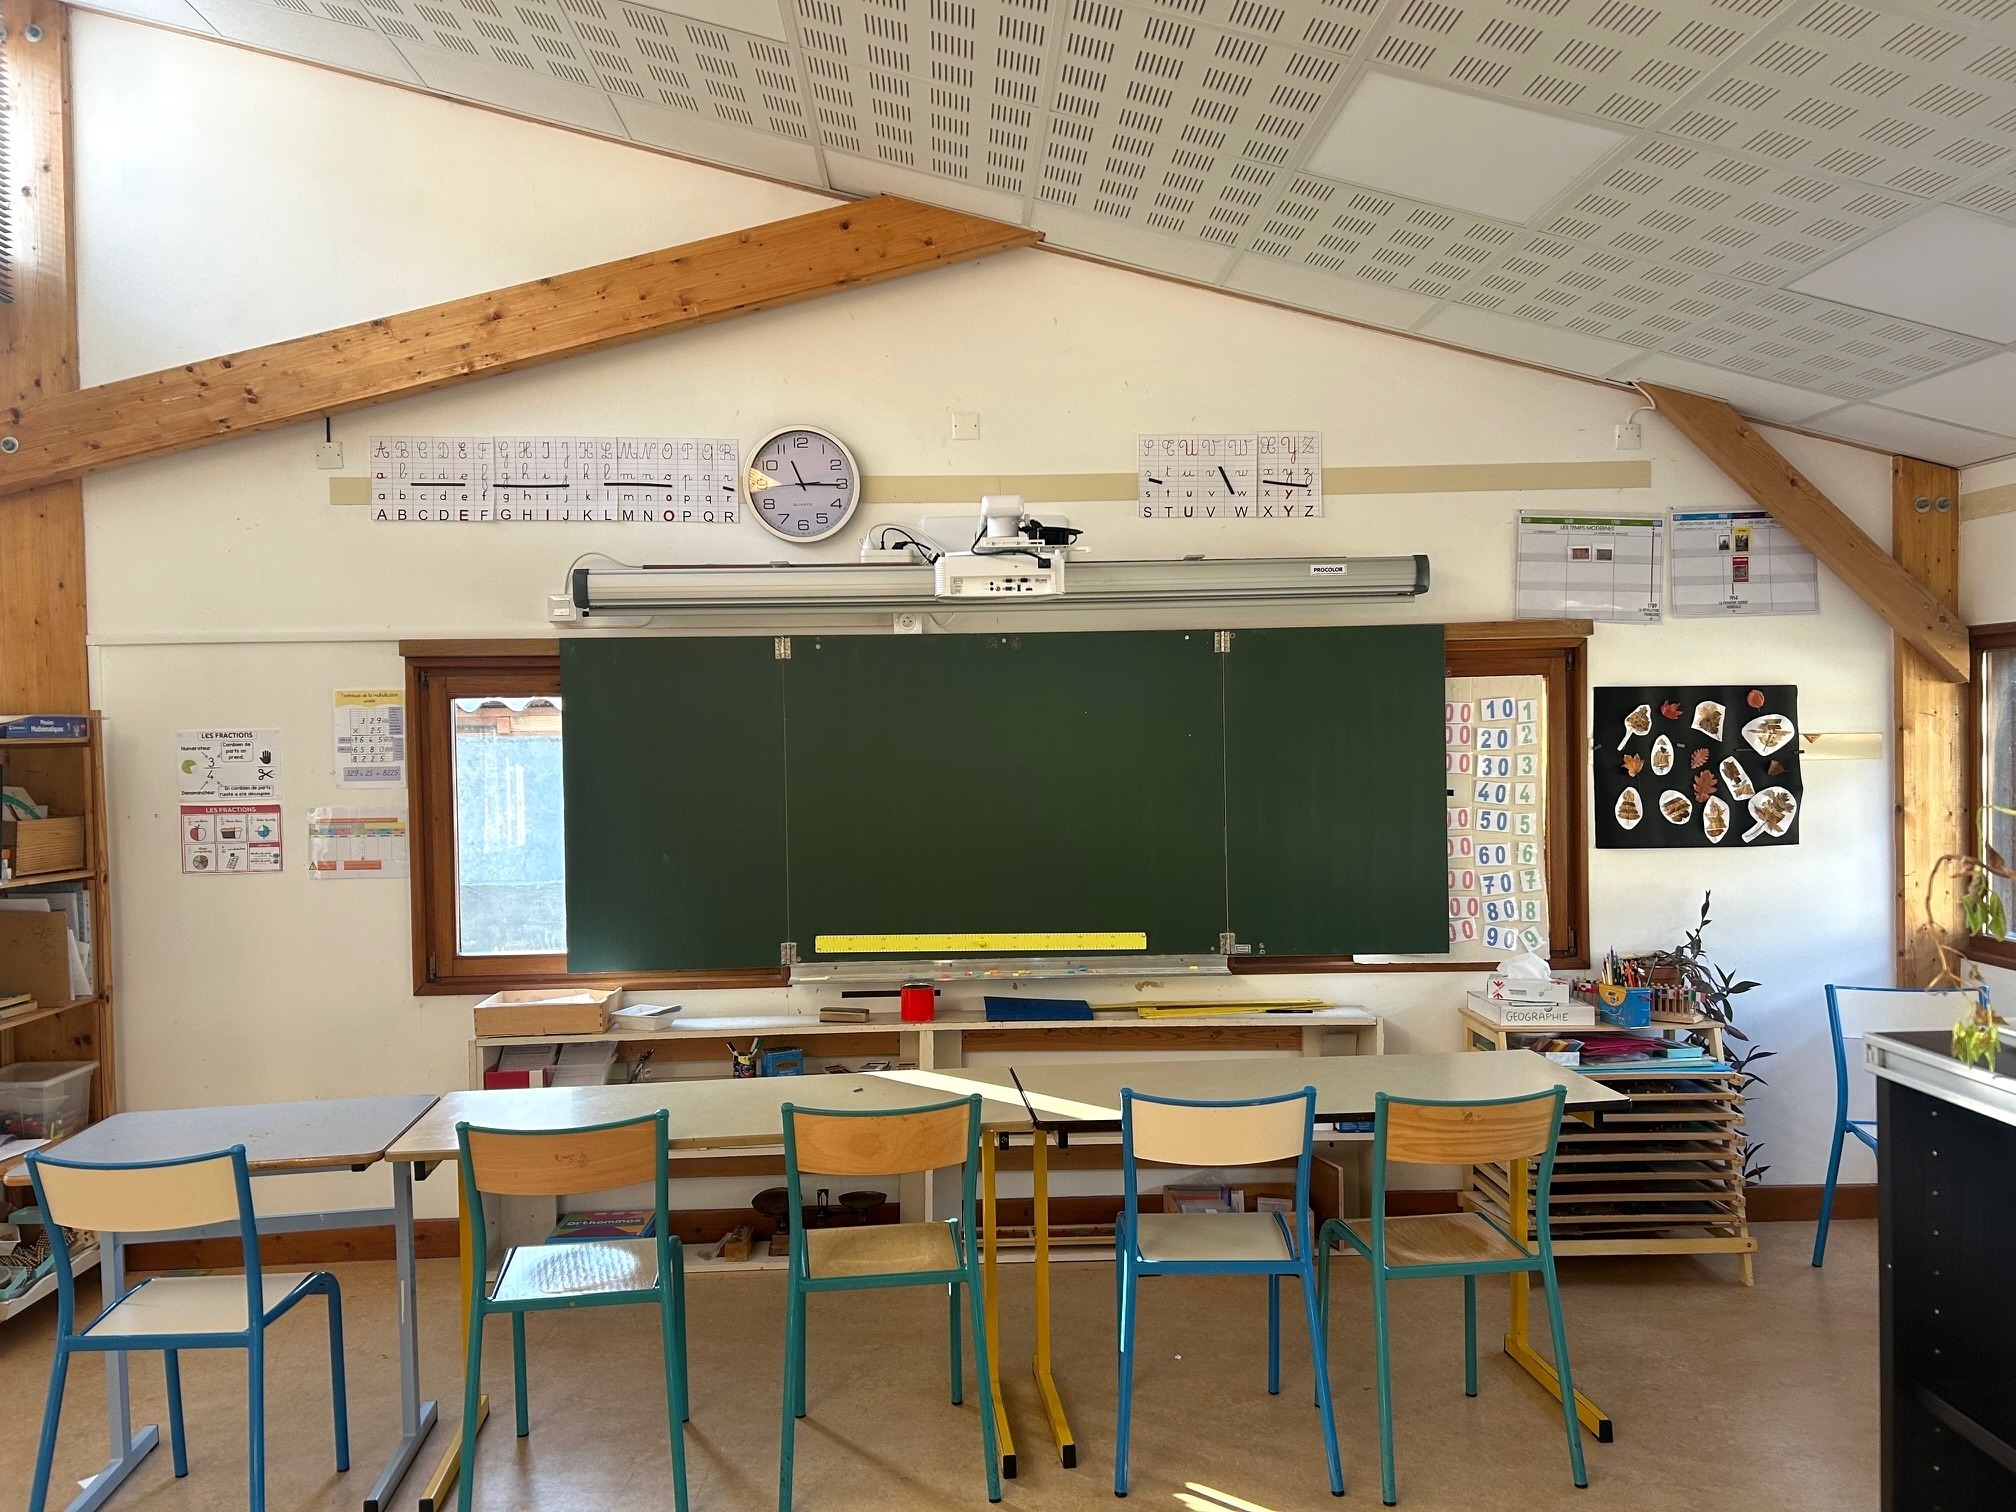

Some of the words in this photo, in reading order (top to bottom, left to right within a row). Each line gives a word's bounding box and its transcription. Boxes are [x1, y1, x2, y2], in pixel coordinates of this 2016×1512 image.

[794, 438, 808, 448] 12
[777, 444, 786, 455] 11
[762, 460, 778, 471] 10
[830, 460, 842, 470] 2
[756, 478, 768, 490] 9
[836, 478, 848, 490] 3
[400, 490, 406, 499] b
[440, 491, 446, 500] d
[482, 489, 487, 500] f
[503, 494, 509, 502] g
[524, 490, 531, 500] h
[565, 494, 567, 503] j
[586, 491, 590, 500] k
[685, 495, 690, 503] p
[705, 496, 711, 504] q
[1167, 489, 1170, 497] t
[1286, 490, 1293, 499] y
[764, 498, 775, 510] 8
[830, 498, 842, 510] 4
[377, 509, 387, 520] A
[398, 510, 406, 520] B
[419, 510, 427, 520] C
[440, 510, 449, 520] D
[460, 510, 468, 521] E
[481, 510, 488, 520] F
[501, 509, 511, 520] G
[523, 510, 531, 520] H
[563, 510, 568, 521] J
[584, 510, 592, 521] K
[605, 510, 611, 520] L
[623, 510, 633, 521] M
[644, 511, 652, 521] N
[664, 510, 674, 521] O
[683, 511, 691, 522] P
[704, 511, 713, 522] Q
[725, 512, 734, 522] R
[1144, 507, 1151, 517] S
[1165, 507, 1173, 517] T
[1184, 506, 1193, 517] U
[1206, 507, 1215, 517] V
[1235, 507, 1248, 517] W
[1263, 506, 1272, 517] X
[1284, 506, 1293, 517] Y
[1305, 506, 1313, 517] Z
[778, 514, 790, 524] 7
[816, 512, 828, 524] 5
[798, 520, 810, 530] 6
[1486, 699, 1512, 718] 10
[1523, 702, 1531, 720] 1
[1481, 730, 1508, 748] 20
[1522, 725, 1532, 744] 2
[208, 757, 214, 768] 3
[1482, 758, 1508, 776] 30
[1522, 756, 1532, 774] 3
[207, 770, 214, 780] 4
[1478, 783, 1506, 802] 40
[1520, 784, 1530, 802] 4
[1480, 811, 1507, 830] 50
[1520, 815, 1530, 833] 5
[1479, 846, 1506, 864] 60
[1522, 844, 1533, 862] 6
[1483, 874, 1511, 894] 70
[1524, 871, 1535, 889] 7
[1487, 900, 1514, 921] 80
[1526, 902, 1535, 920] 8
[1487, 928, 1514, 948] 90
[1524, 930, 1538, 947] 9
[1506, 1011, 1568, 1021] GEOGRAPHIE
